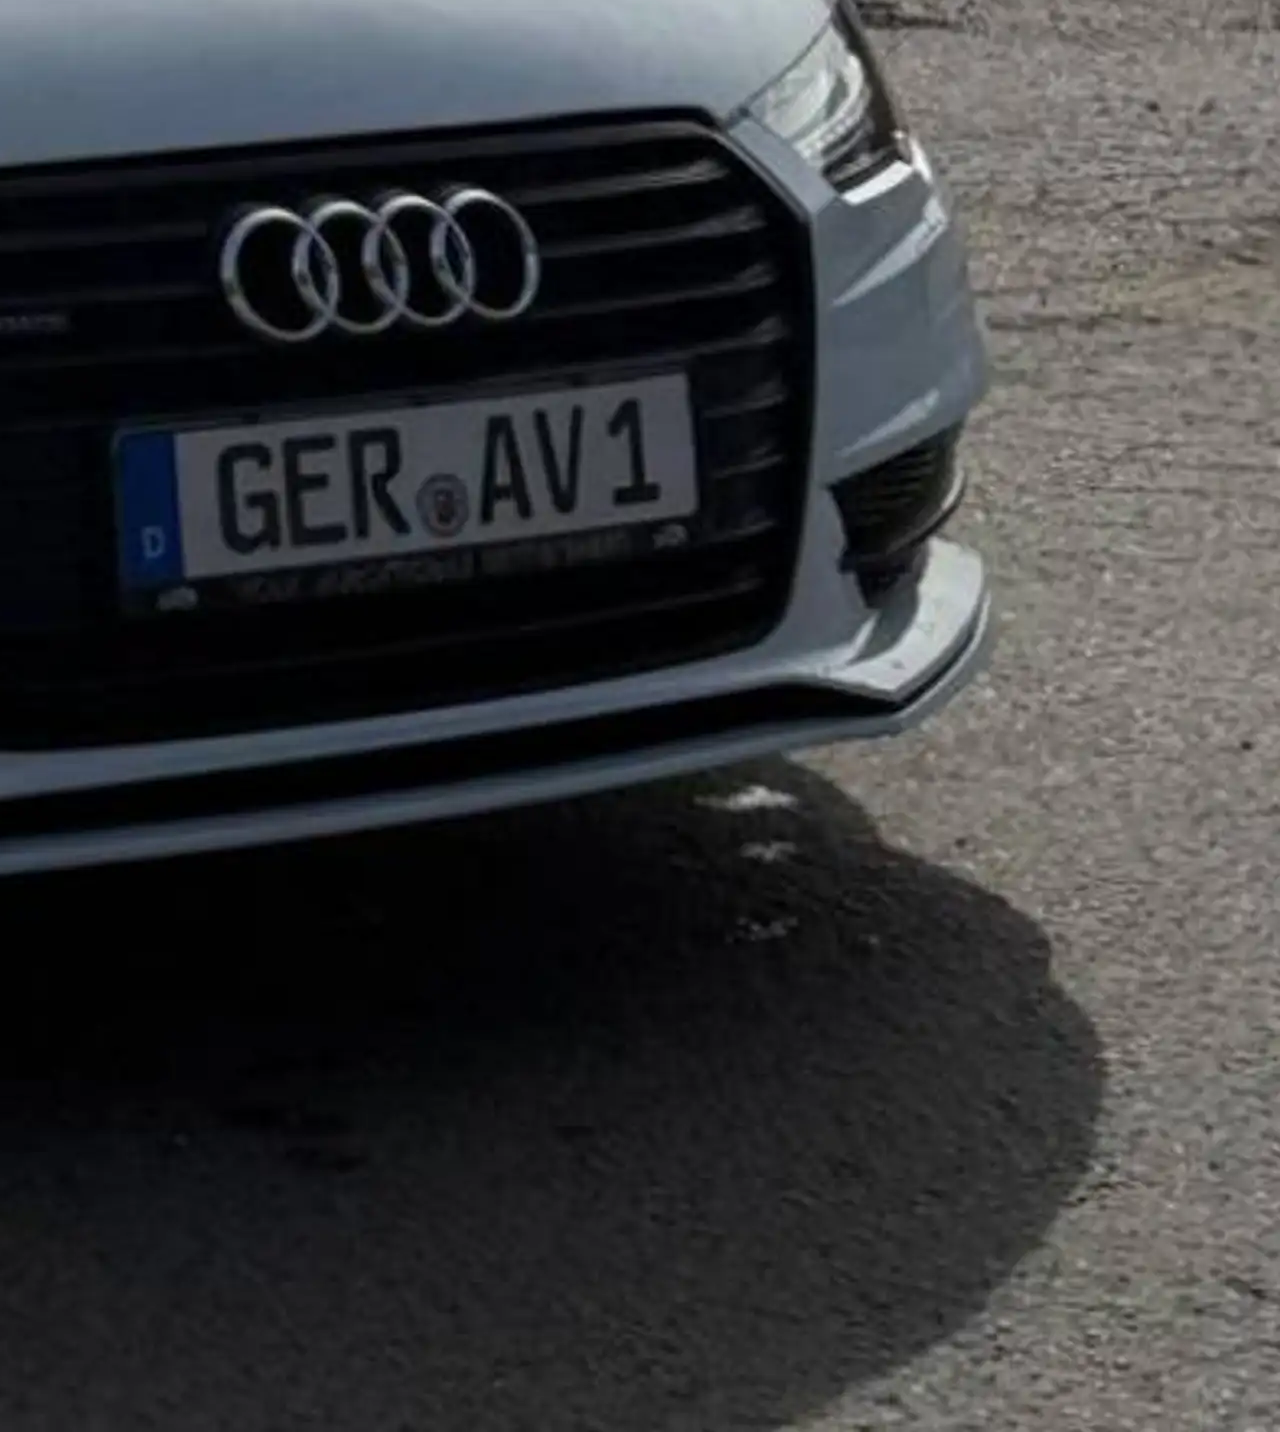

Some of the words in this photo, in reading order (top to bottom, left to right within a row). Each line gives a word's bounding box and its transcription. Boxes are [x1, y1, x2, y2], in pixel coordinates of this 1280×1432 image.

[216, 427, 411, 555] GER
[478, 404, 584, 525] AV
[606, 397, 661, 506] 1
[142, 525, 167, 560] D
